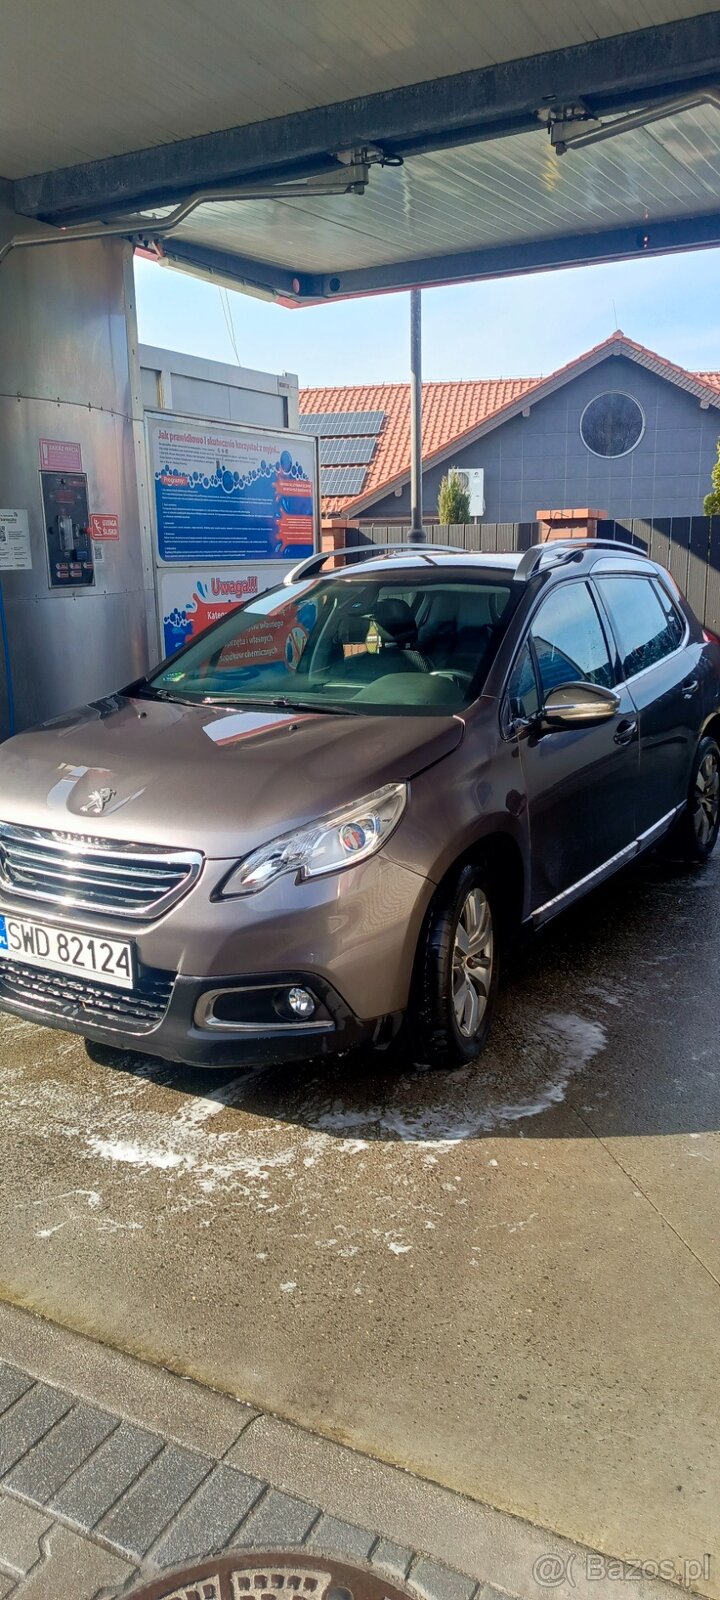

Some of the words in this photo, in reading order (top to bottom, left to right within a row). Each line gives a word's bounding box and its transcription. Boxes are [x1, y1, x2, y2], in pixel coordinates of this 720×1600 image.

[158, 430, 169, 440] Jak
[102, 519, 117, 527] UWAGA
[211, 576, 258, 598] Uwaga!!!
[8, 922, 50, 957] SWD
[56, 933, 130, 977] 82124
